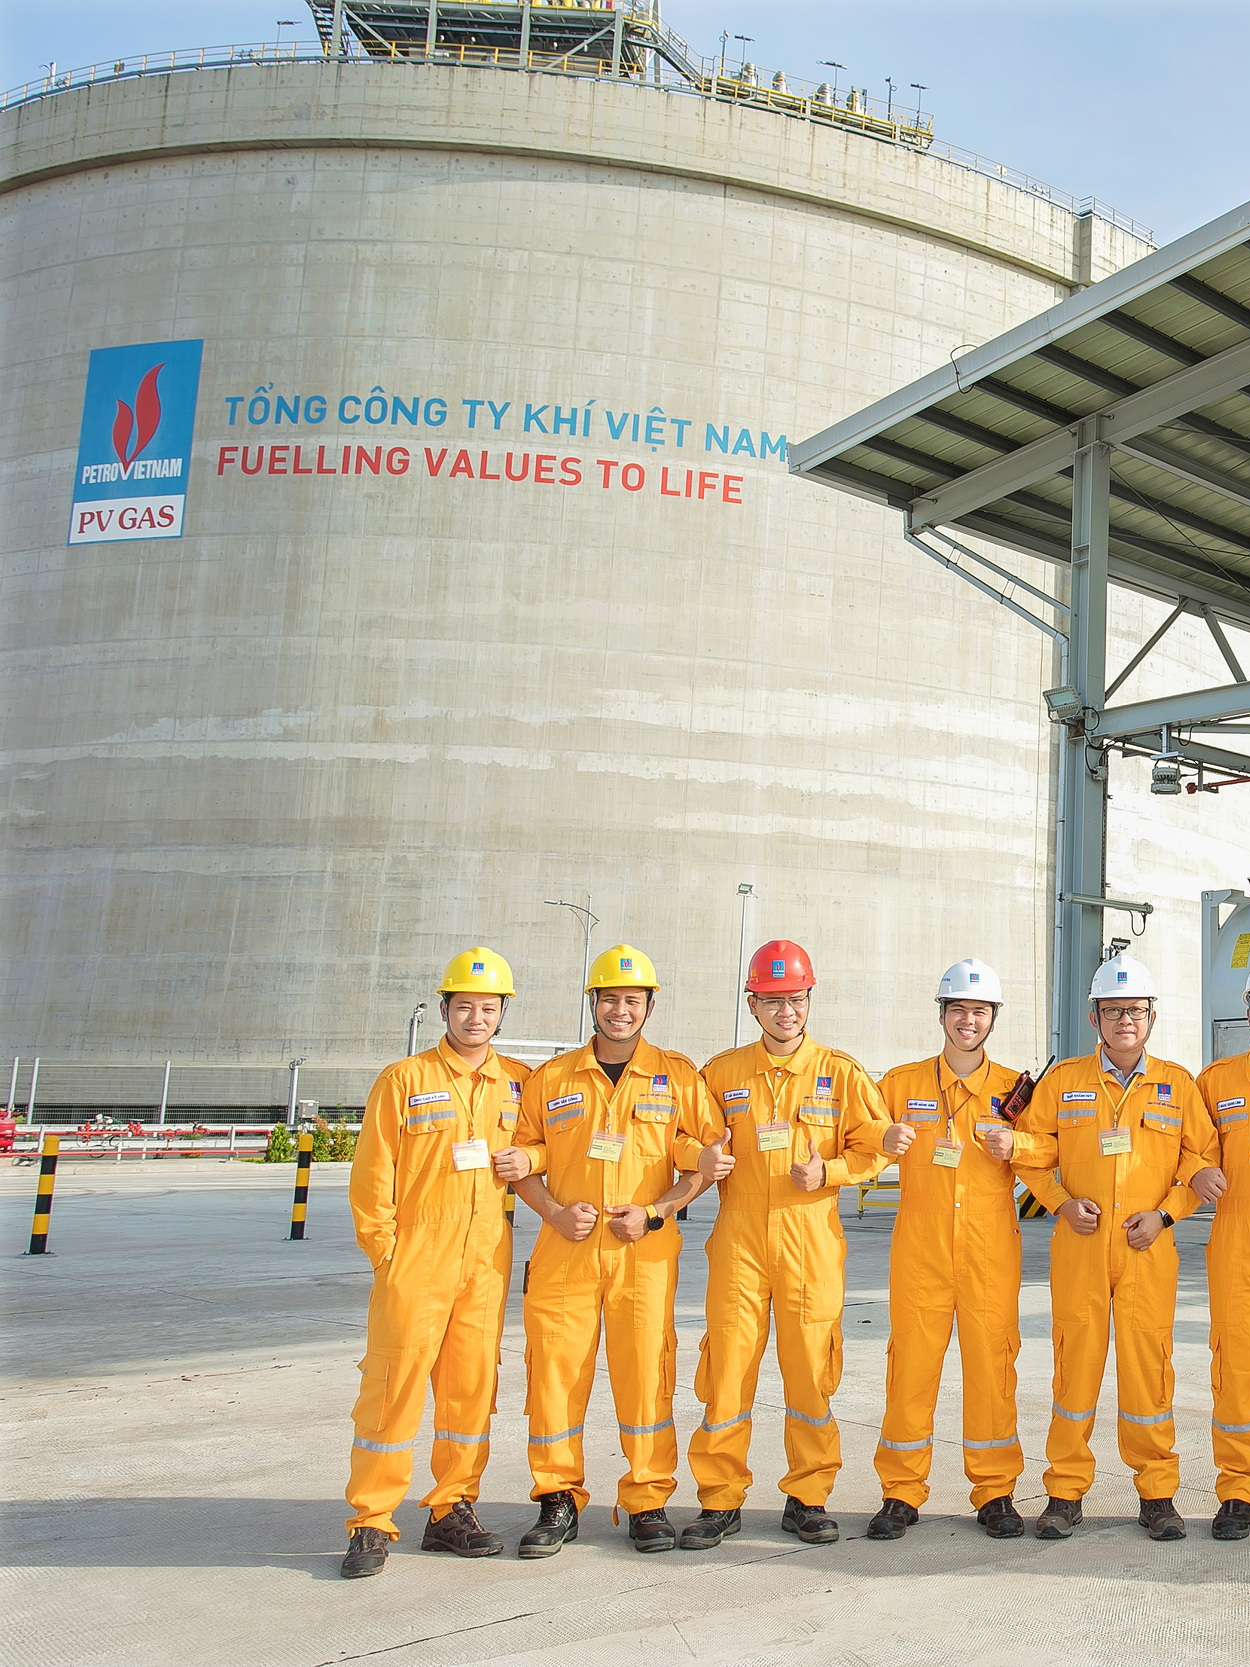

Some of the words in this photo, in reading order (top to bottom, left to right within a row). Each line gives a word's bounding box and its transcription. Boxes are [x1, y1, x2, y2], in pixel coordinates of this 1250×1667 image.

[225, 382, 327, 426] TỔNG
[338, 385, 447, 427] CÔNG
[462, 400, 511, 430] TY
[524, 399, 596, 437] KHÍ
[605, 406, 692, 452] VIỆT
[704, 424, 788, 462] NAM
[82, 458, 183, 485] PETROVIETNAM
[217, 445, 410, 476] FUELLING
[423, 447, 583, 487] VALUES
[596, 459, 646, 492] TO
[660, 467, 744, 505] LIFE
[77, 509, 115, 534] PV
[118, 505, 175, 530] GAS
